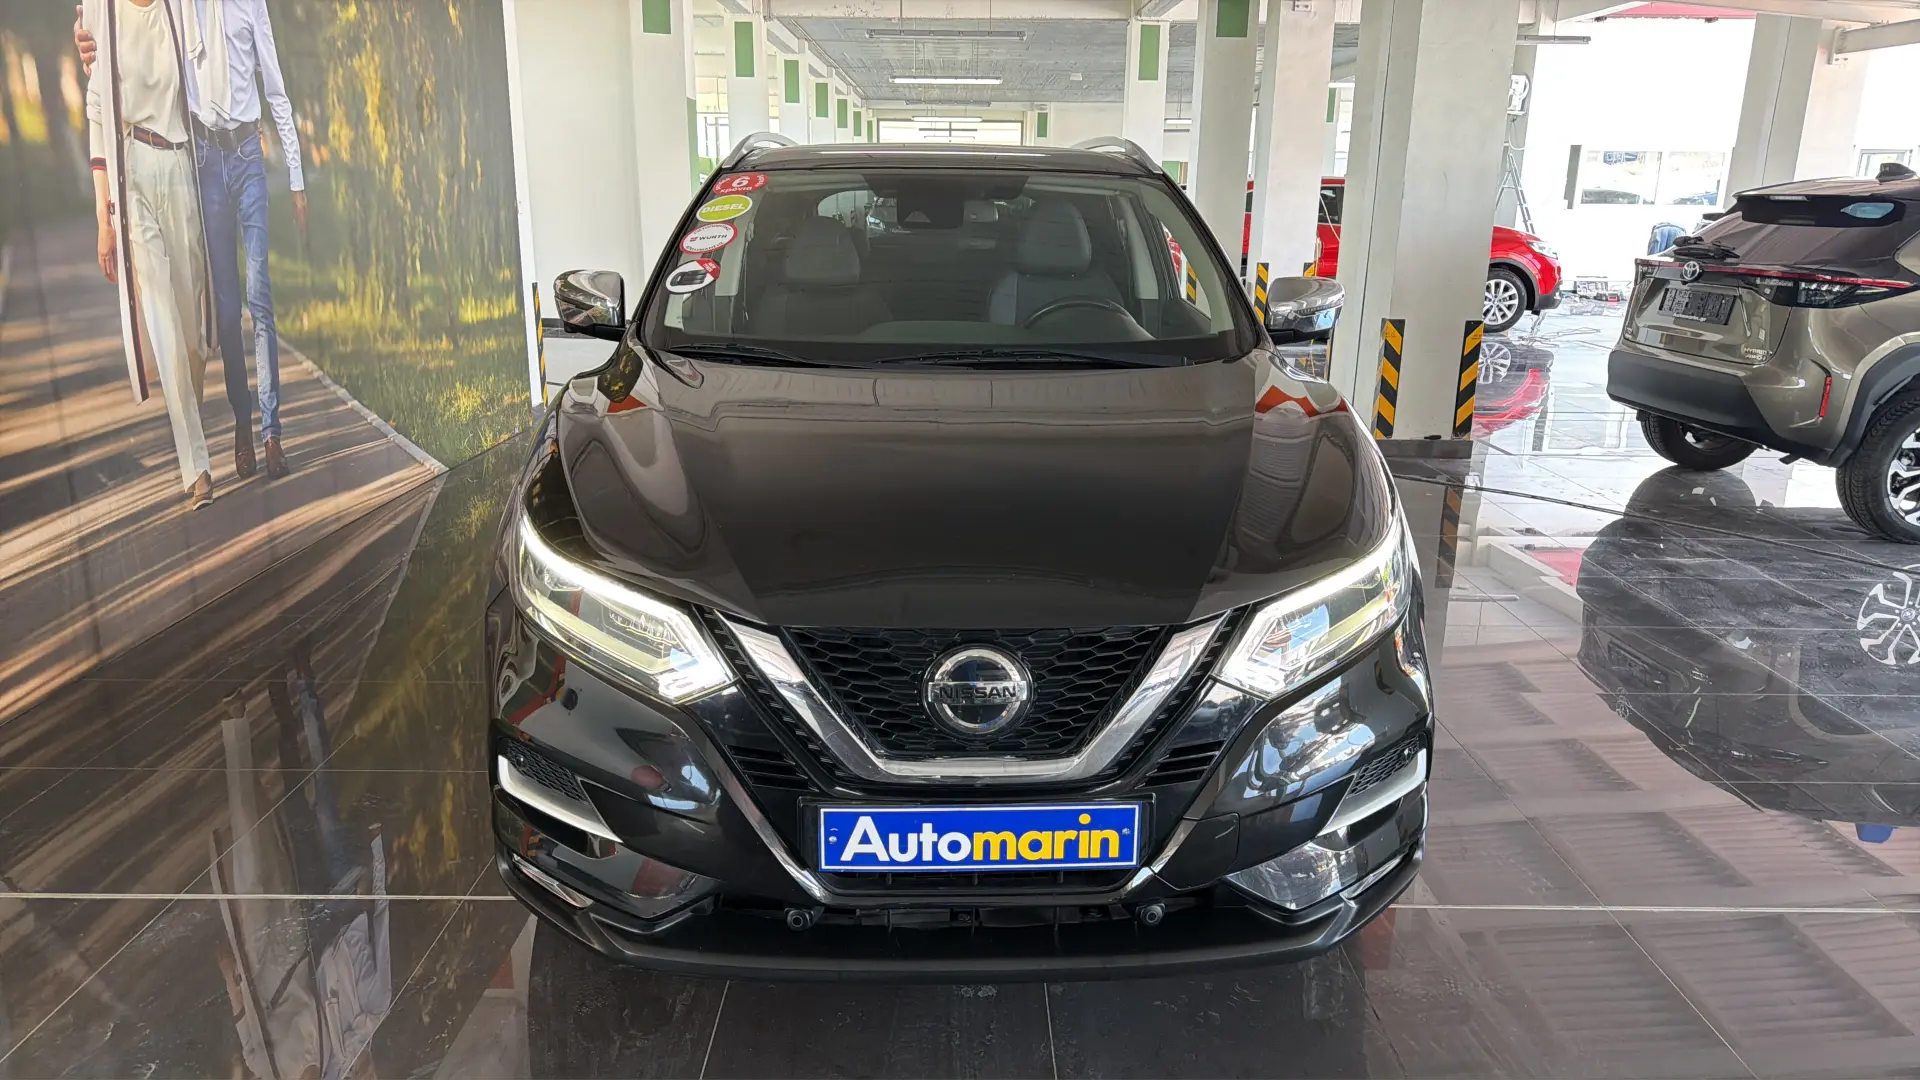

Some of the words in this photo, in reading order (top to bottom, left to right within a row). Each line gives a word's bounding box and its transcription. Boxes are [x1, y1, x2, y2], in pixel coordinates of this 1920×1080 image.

[731, 175, 750, 187] 6
[702, 203, 745, 213] DIESEL
[939, 685, 1017, 699] NISSAN
[840, 813, 1119, 861] Automarin
